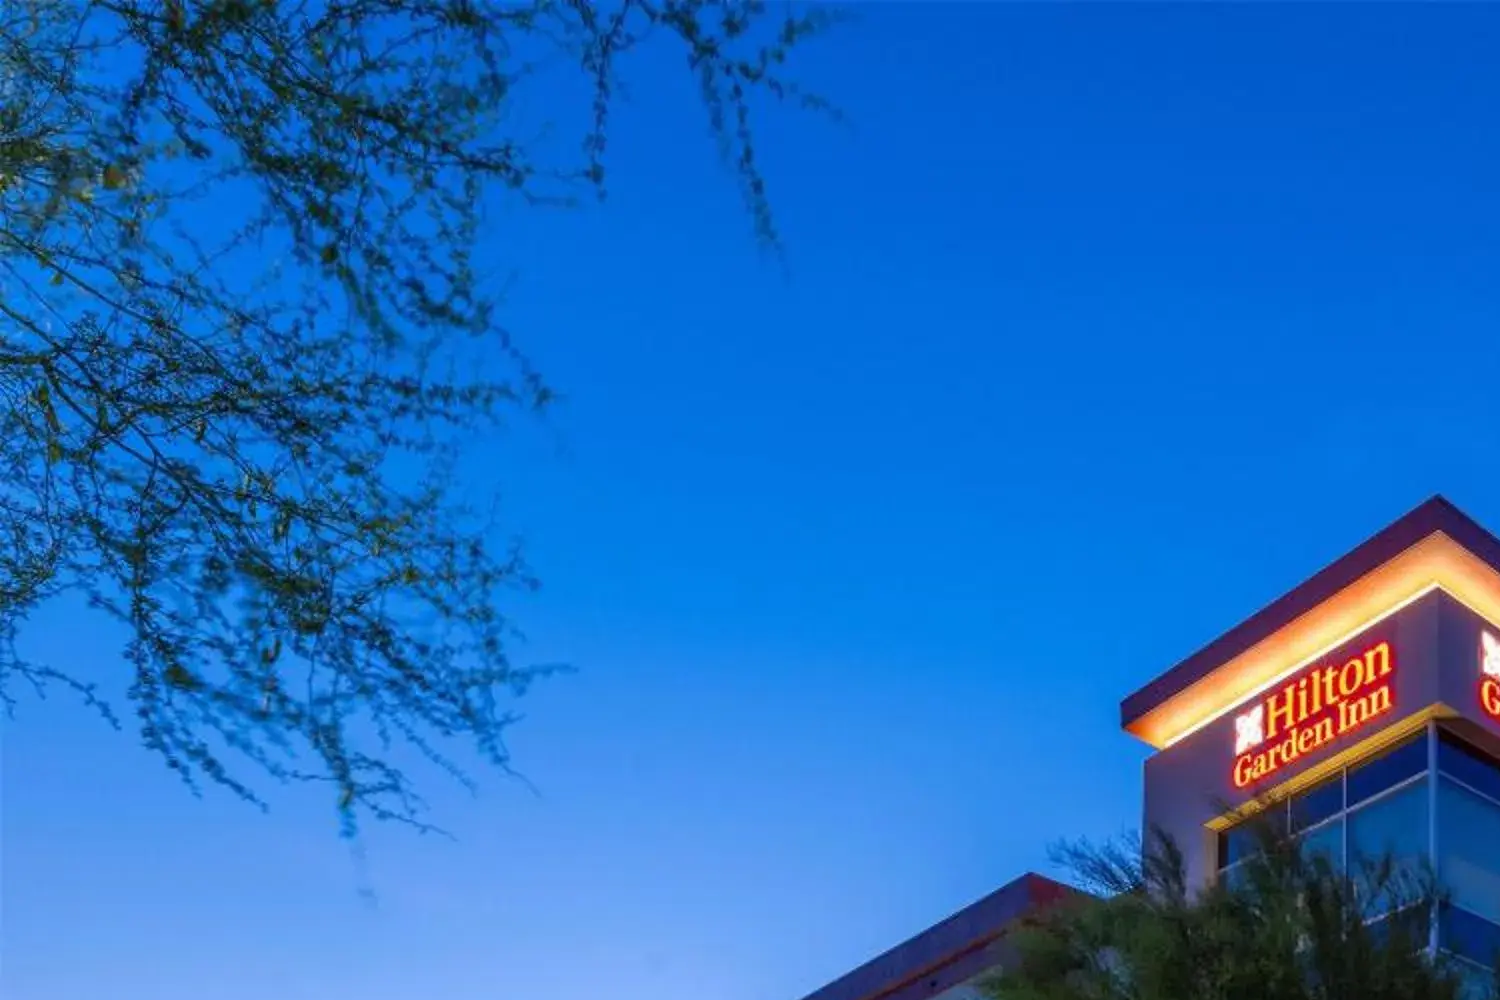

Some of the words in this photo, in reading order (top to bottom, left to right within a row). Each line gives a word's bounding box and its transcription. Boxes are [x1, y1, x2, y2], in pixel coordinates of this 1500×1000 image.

[1233, 717, 1334, 787] Garden
[1337, 685, 1392, 733] Inn
[1266, 641, 1392, 739] Hilton
